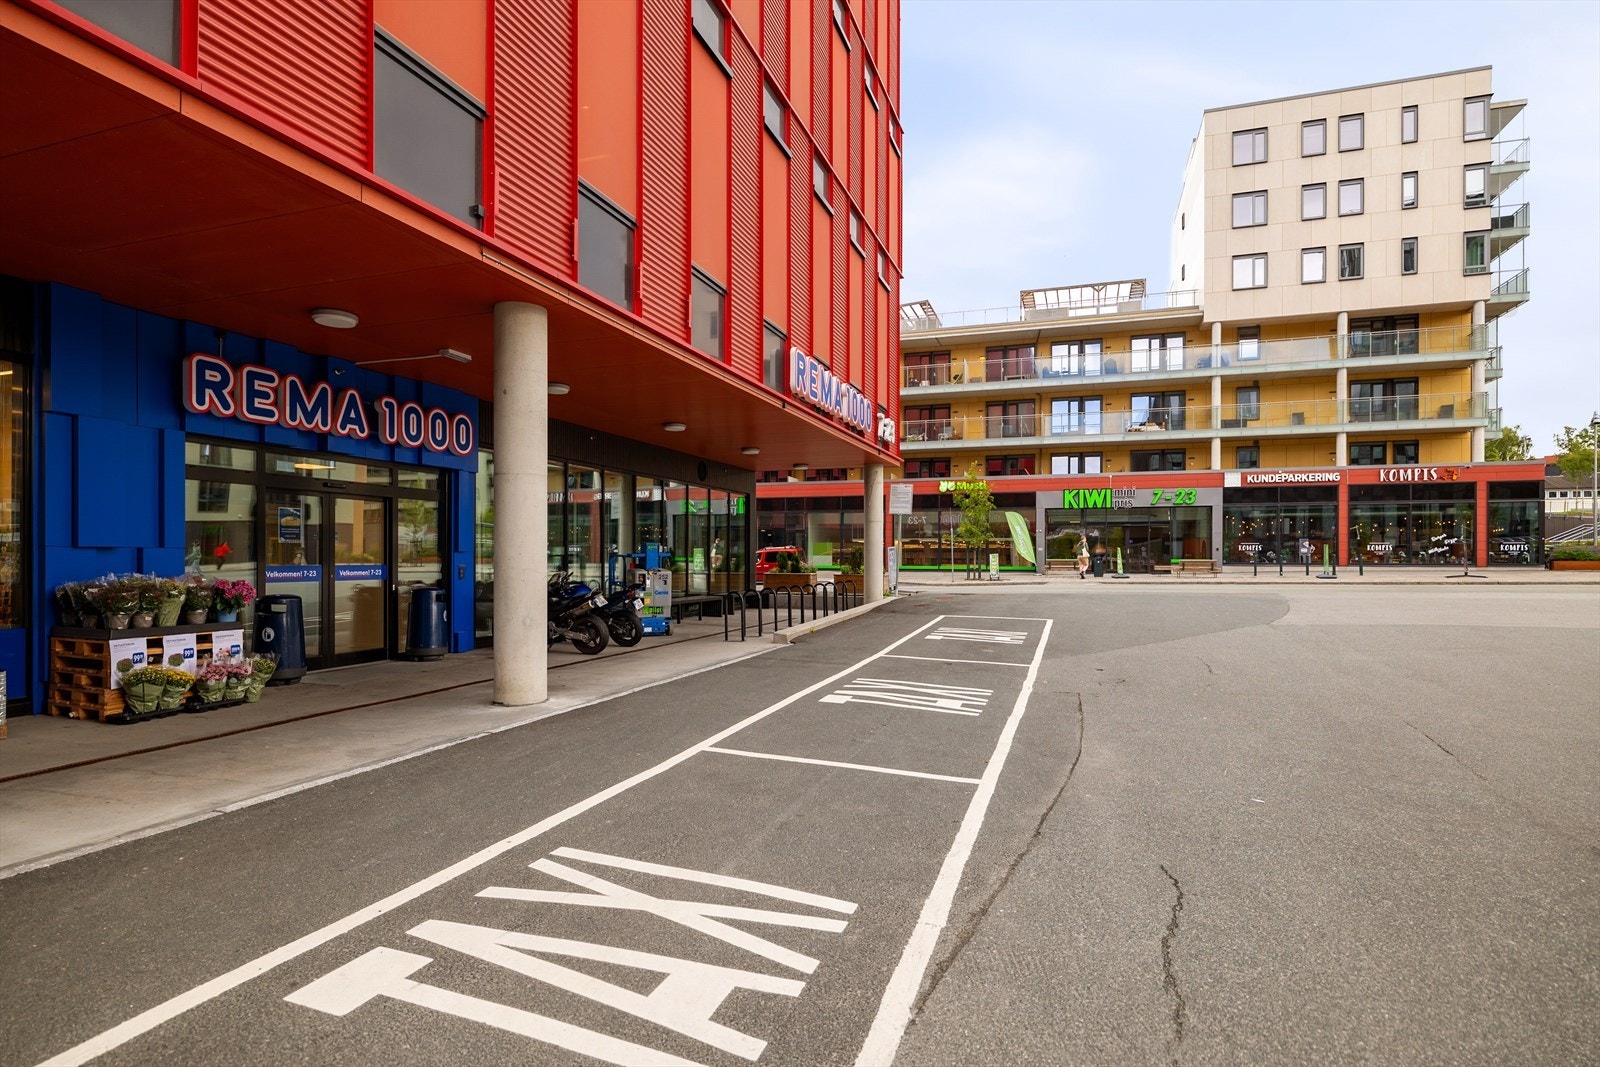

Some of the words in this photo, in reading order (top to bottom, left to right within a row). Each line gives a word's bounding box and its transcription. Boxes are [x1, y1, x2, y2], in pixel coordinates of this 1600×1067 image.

[791, 347, 843, 418] REMA
[841, 383, 873, 434] 1000
[187, 353, 370, 439] REMA
[376, 396, 473, 456] 1000
[1247, 472, 1341, 484] KUNDEPARKERING
[1379, 467, 1438, 482] KOMPIS
[1063, 488, 1113, 509] KIWI
[1114, 486, 1137, 497] mini
[1113, 498, 1134, 510] pris
[265, 569, 303, 578] Velkommen!
[303, 569, 317, 577] 7-23
[339, 568, 370, 576] Velkommen!
[370, 568, 382, 576] 7-23
[818, 677, 994, 717] TAXI
[283, 846, 858, 1067] TAXI
